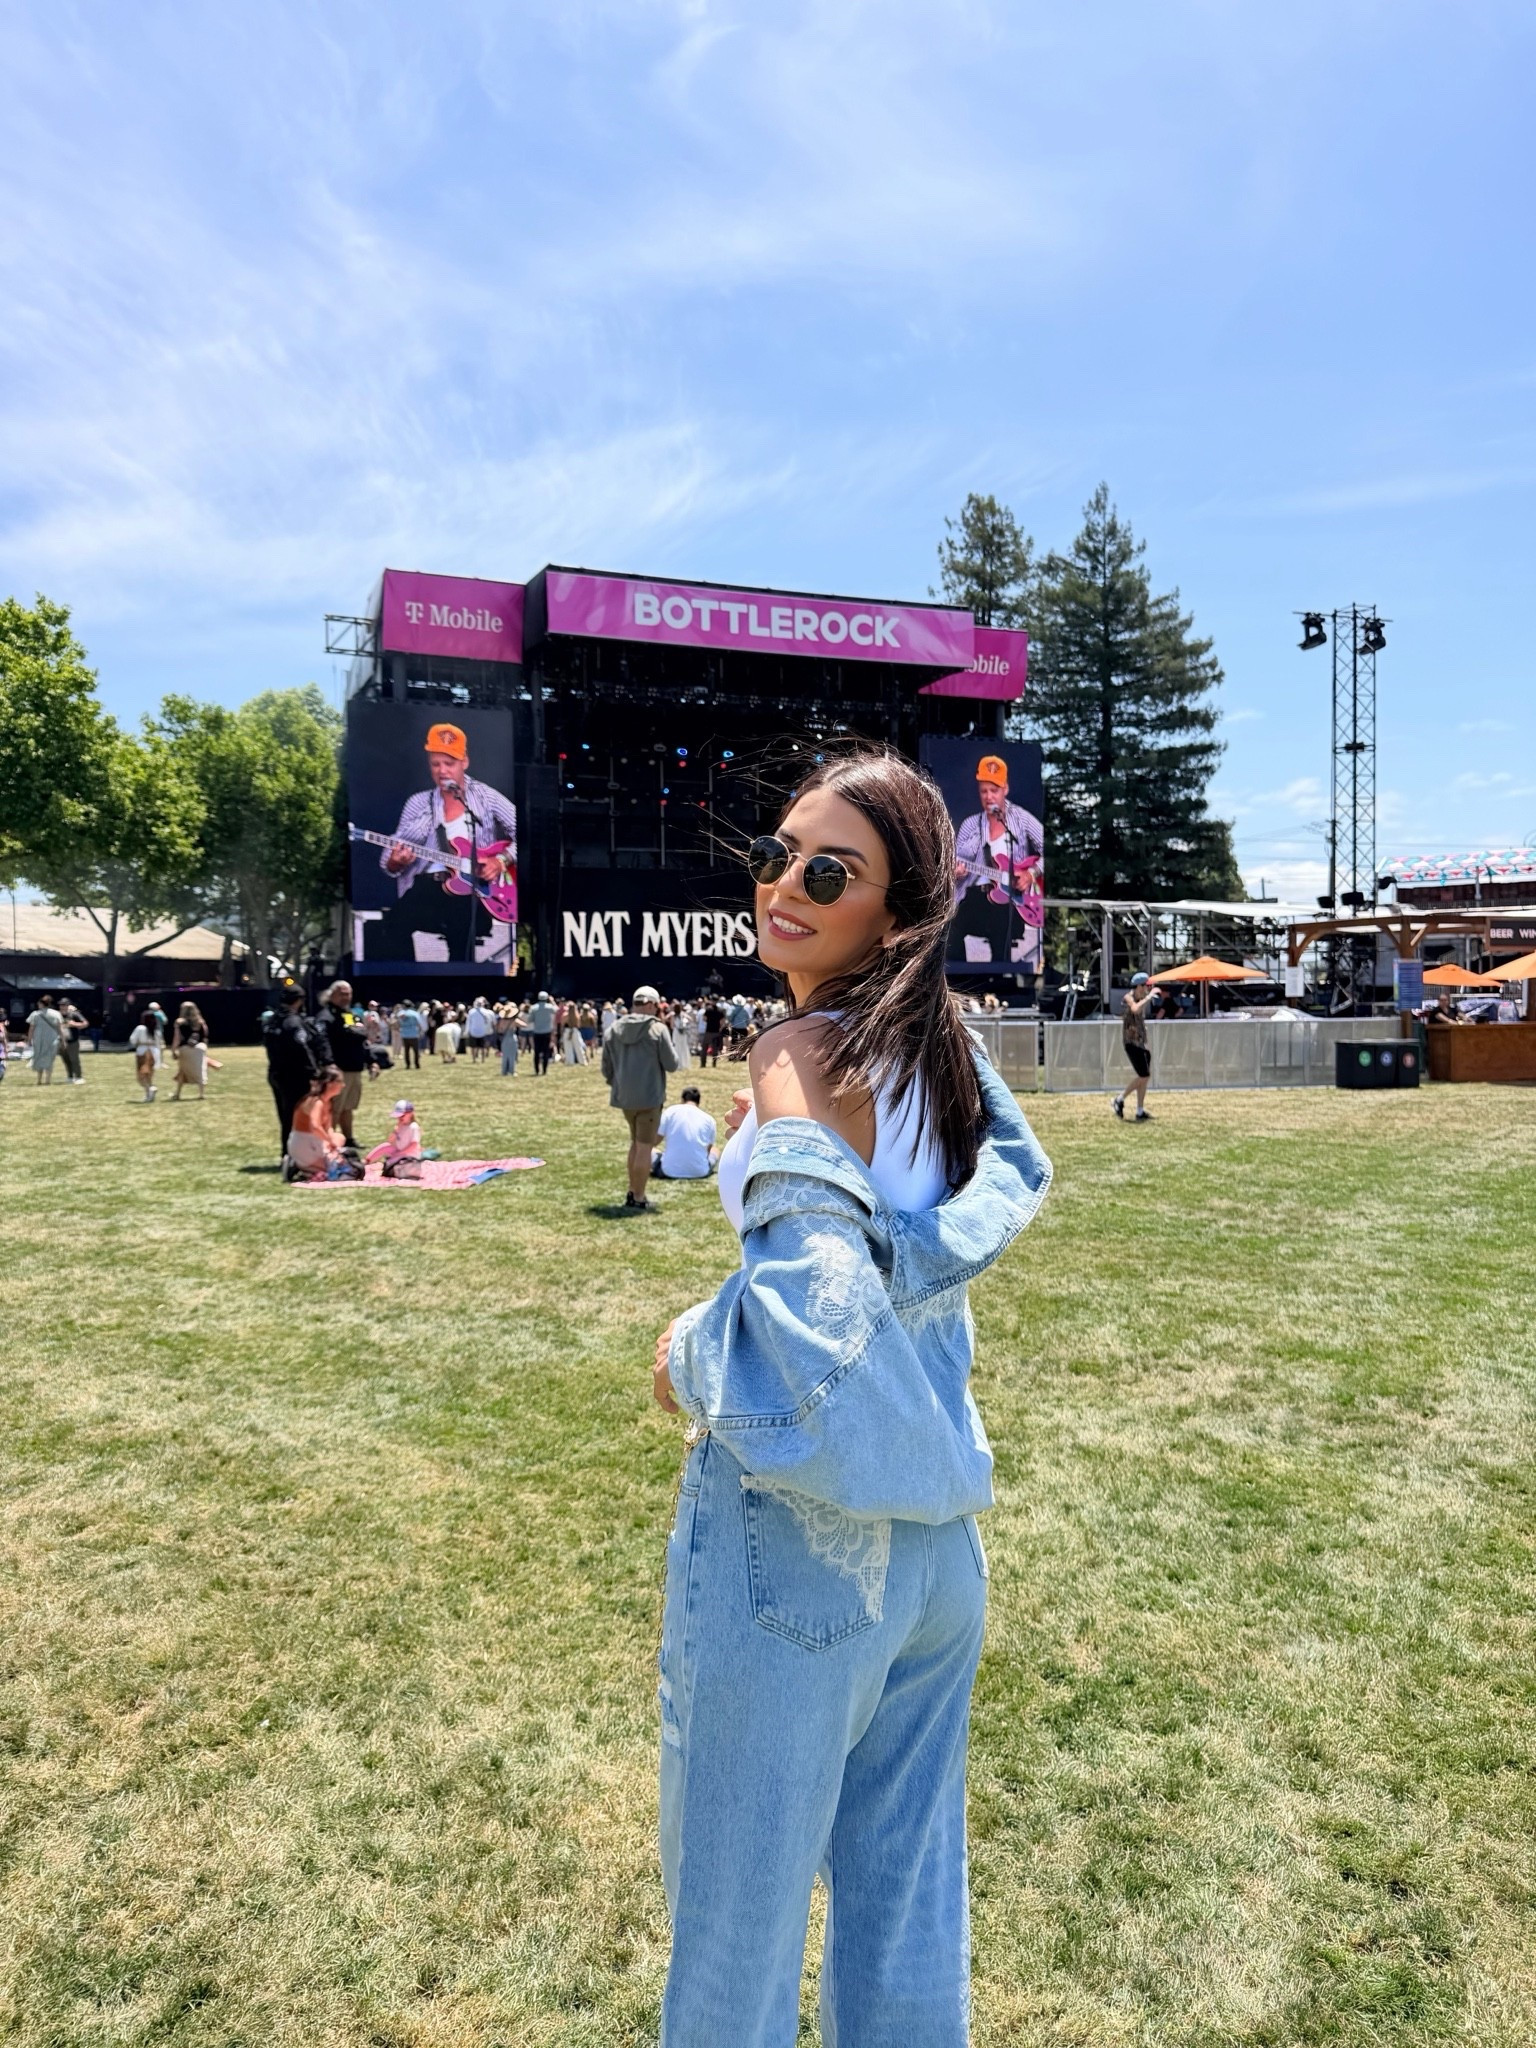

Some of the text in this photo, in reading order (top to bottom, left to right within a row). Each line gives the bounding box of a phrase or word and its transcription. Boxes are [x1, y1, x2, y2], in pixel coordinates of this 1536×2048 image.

[429, 603, 504, 633] Mobile
[634, 592, 901, 648] BOTTLEROCK
[964, 653, 1010, 676] obile
[562, 911, 757, 957] NAT MYERS
[1490, 928, 1514, 939] BEER
